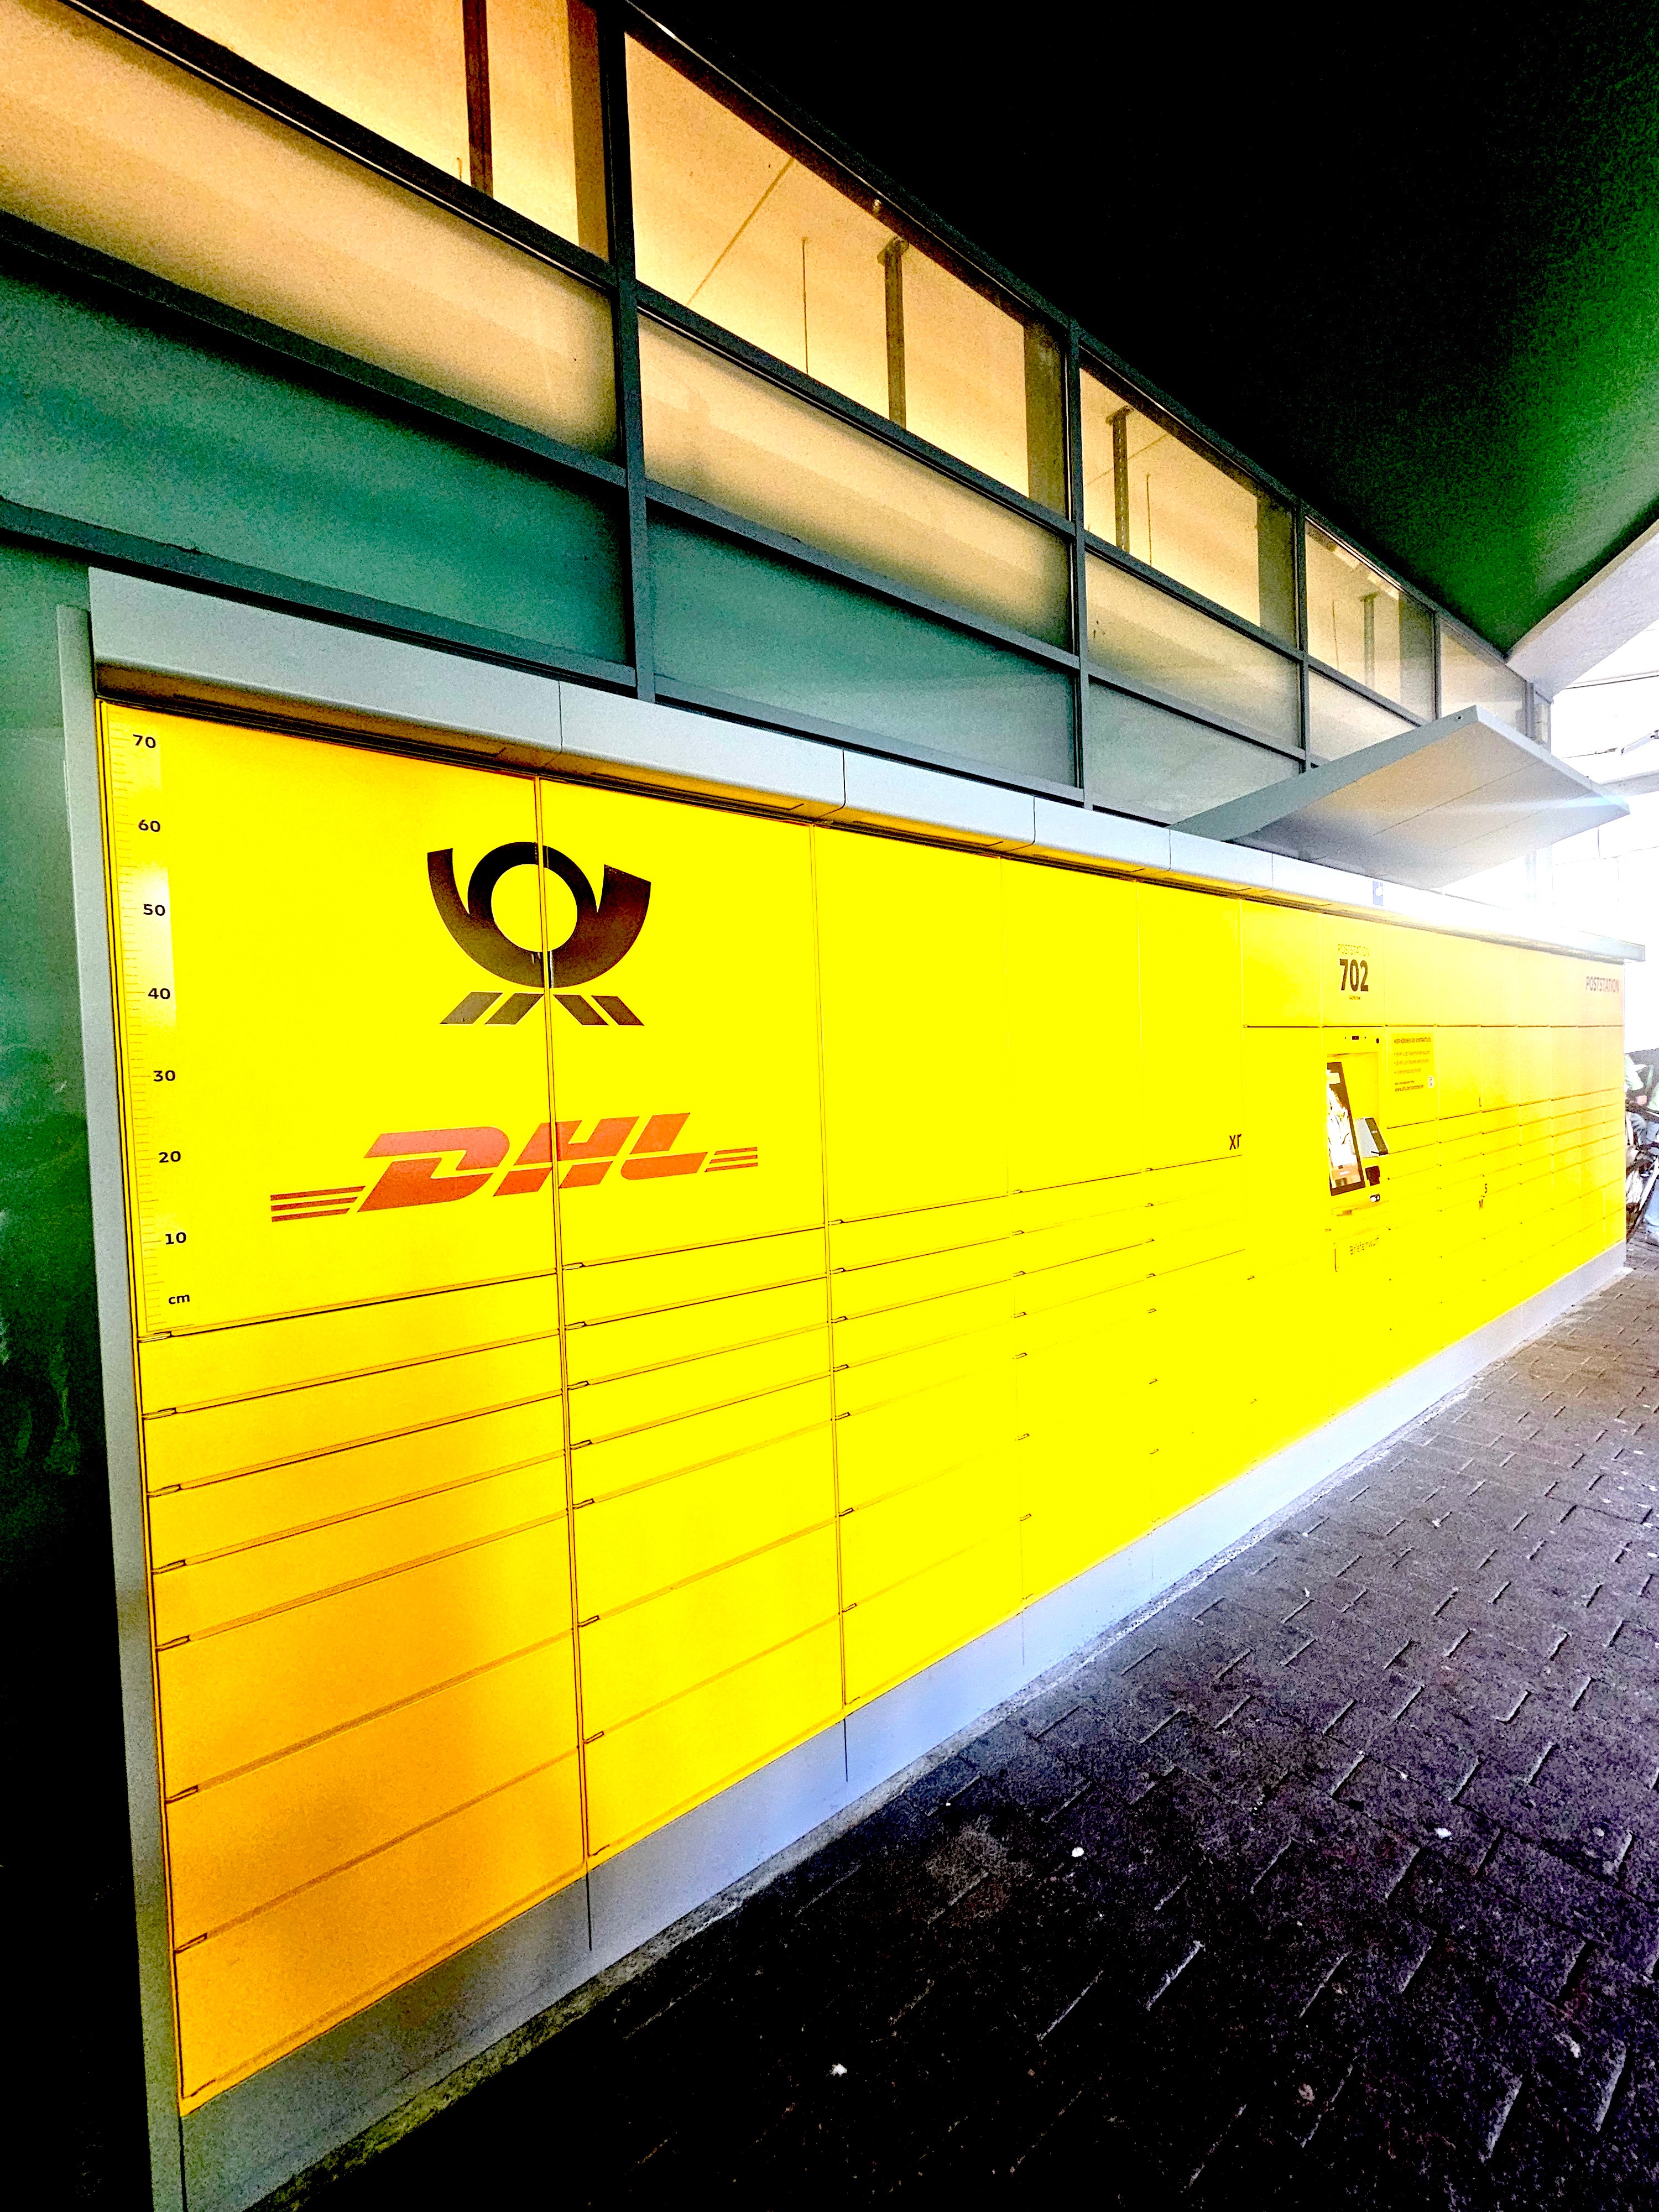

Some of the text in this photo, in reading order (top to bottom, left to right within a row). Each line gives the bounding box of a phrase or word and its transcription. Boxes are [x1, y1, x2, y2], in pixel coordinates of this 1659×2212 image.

[133, 734, 156, 749] 70
[138, 819, 161, 832] 60
[143, 904, 166, 916] 50
[1339, 958, 1369, 992] 702
[1585, 975, 1620, 993] POSTSTATION
[148, 988, 171, 1000] 40
[153, 1070, 176, 1082] 30
[158, 1151, 181, 1163] 20
[357, 1113, 708, 1212] DHL
[165, 1232, 186, 1245] 10
[168, 1294, 190, 1305] cm
